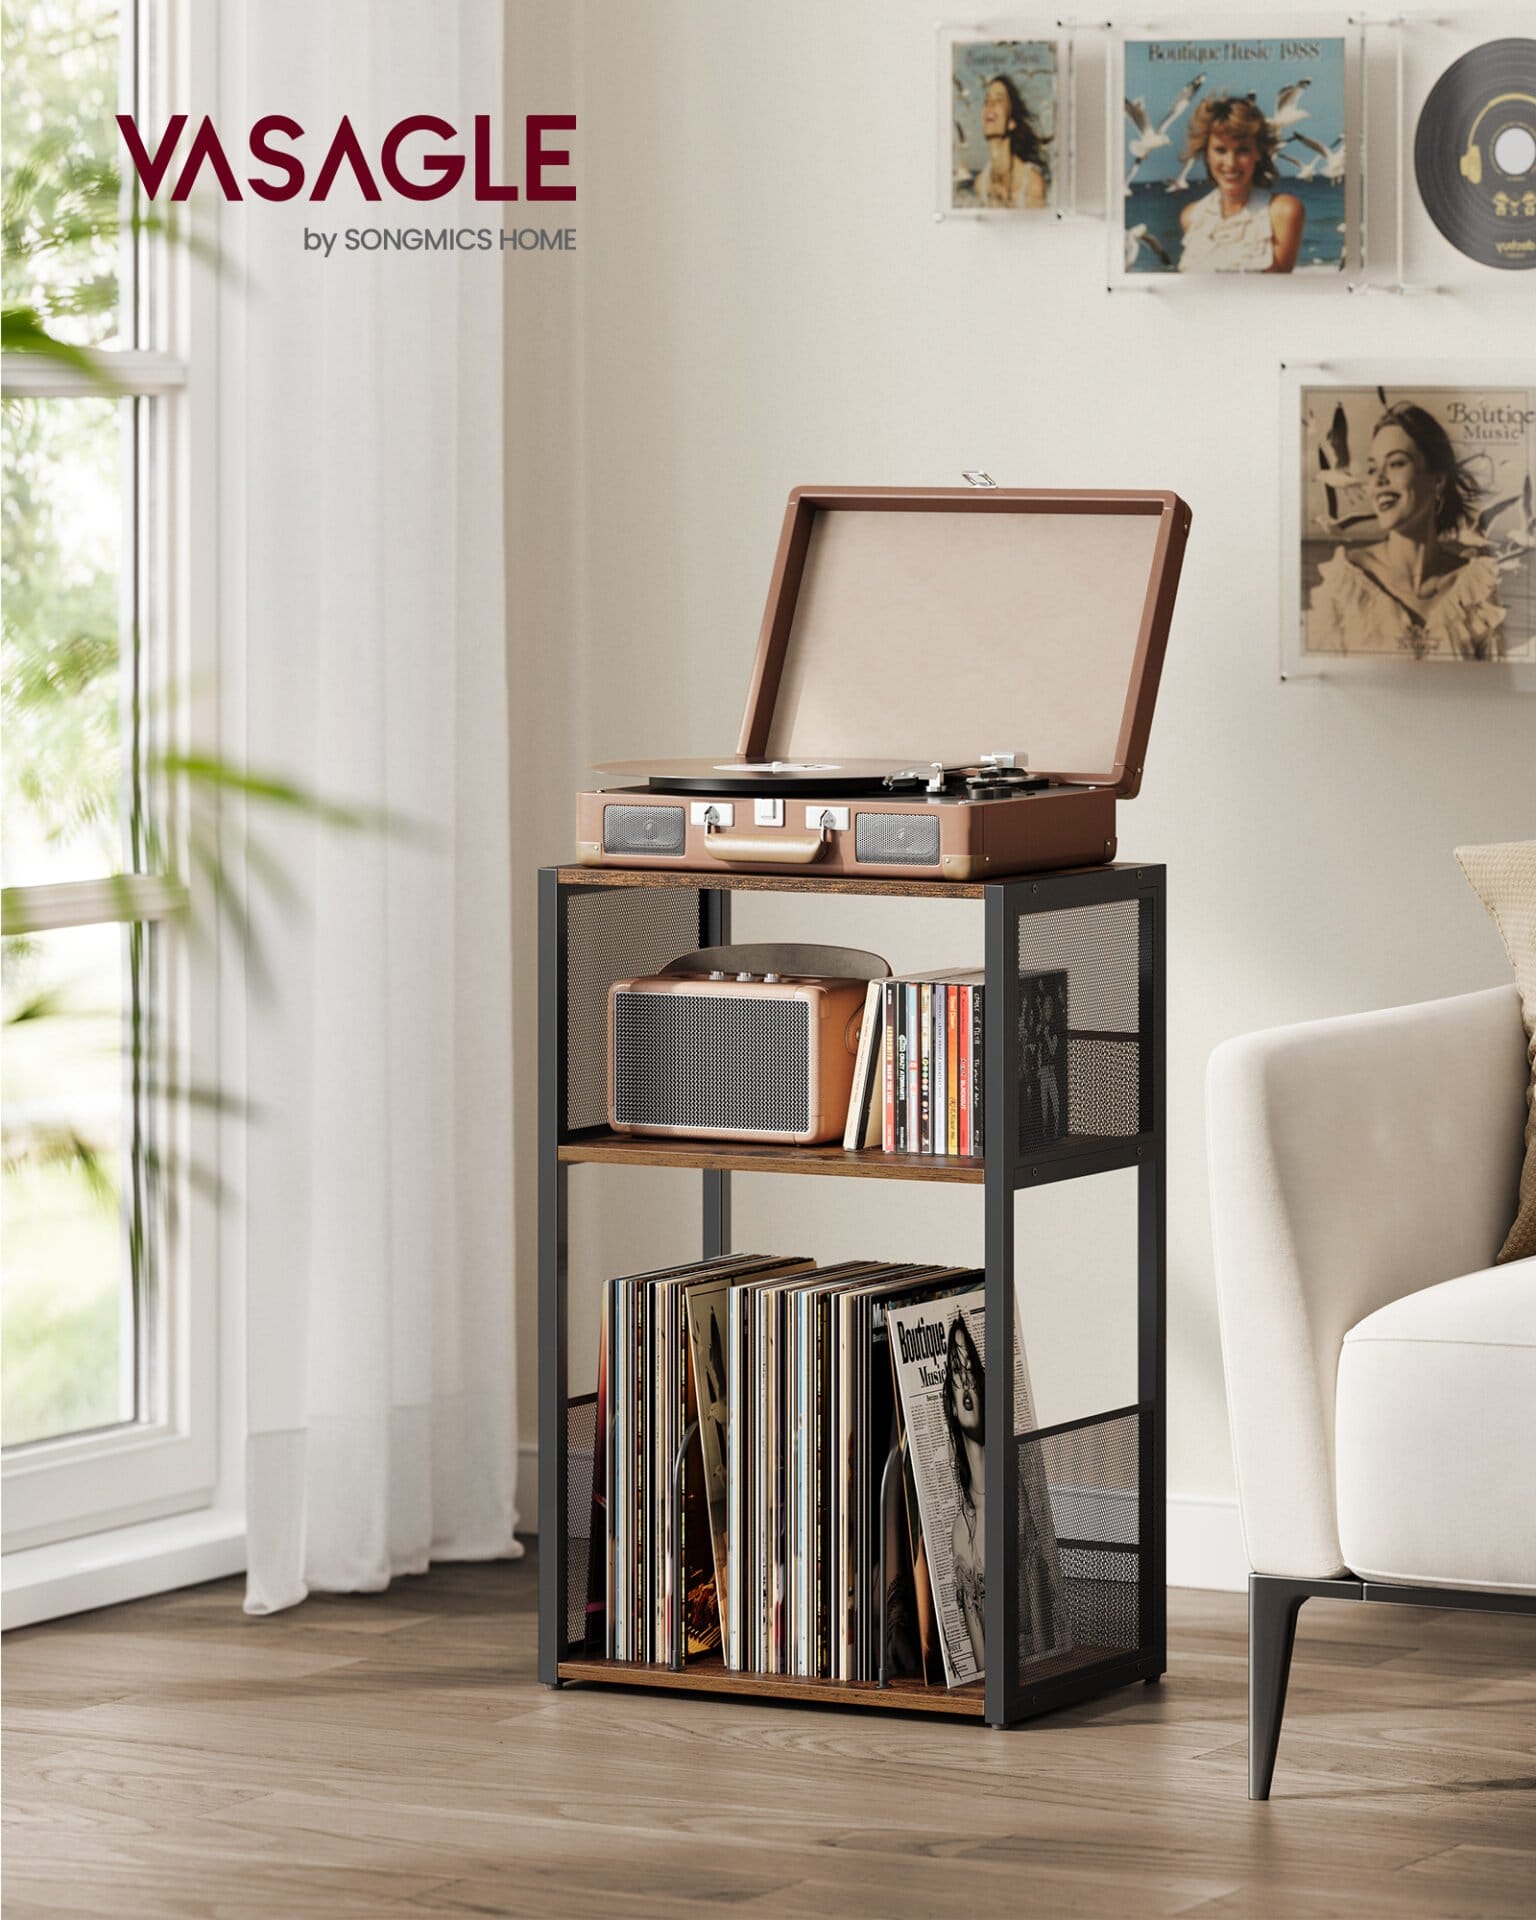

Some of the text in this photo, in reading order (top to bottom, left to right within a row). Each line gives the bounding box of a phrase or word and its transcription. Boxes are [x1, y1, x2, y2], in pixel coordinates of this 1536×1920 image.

[1148, 42, 1220, 64] Boutique
[1279, 40, 1321, 60] 1988
[1464, 424, 1520, 440] Music
[897, 1316, 948, 1367] Boutique
[918, 1363, 946, 1389] Music
